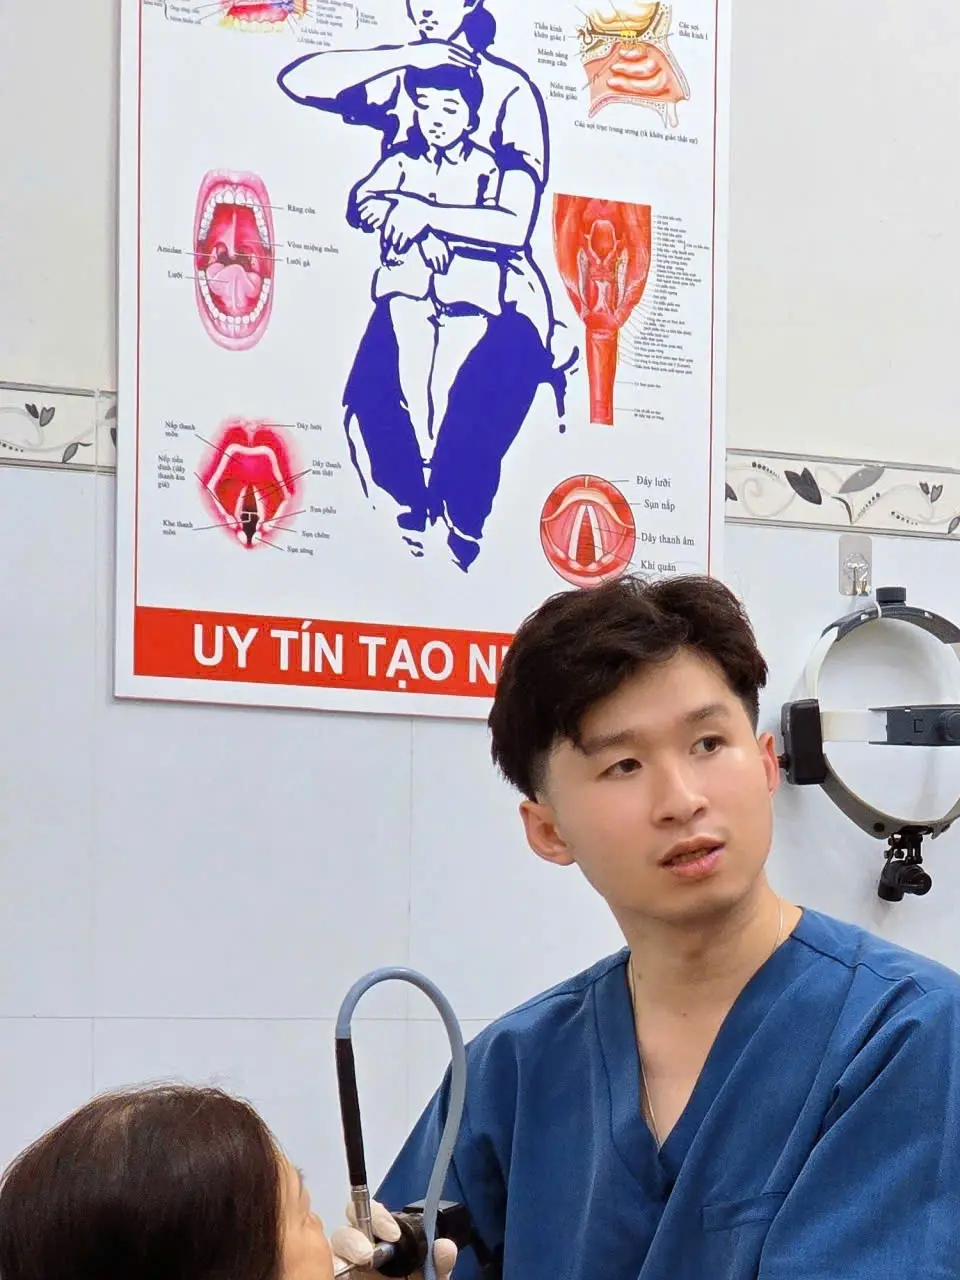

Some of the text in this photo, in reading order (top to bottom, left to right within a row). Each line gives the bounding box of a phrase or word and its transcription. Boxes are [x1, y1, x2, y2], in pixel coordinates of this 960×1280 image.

[644, 499, 659, 510] Sụn
[659, 534, 680, 545] thanh
[641, 560, 655, 570] Khí
[193, 623, 258, 669] UY
[271, 620, 343, 675] TÍN
[359, 635, 454, 688] TẠO
